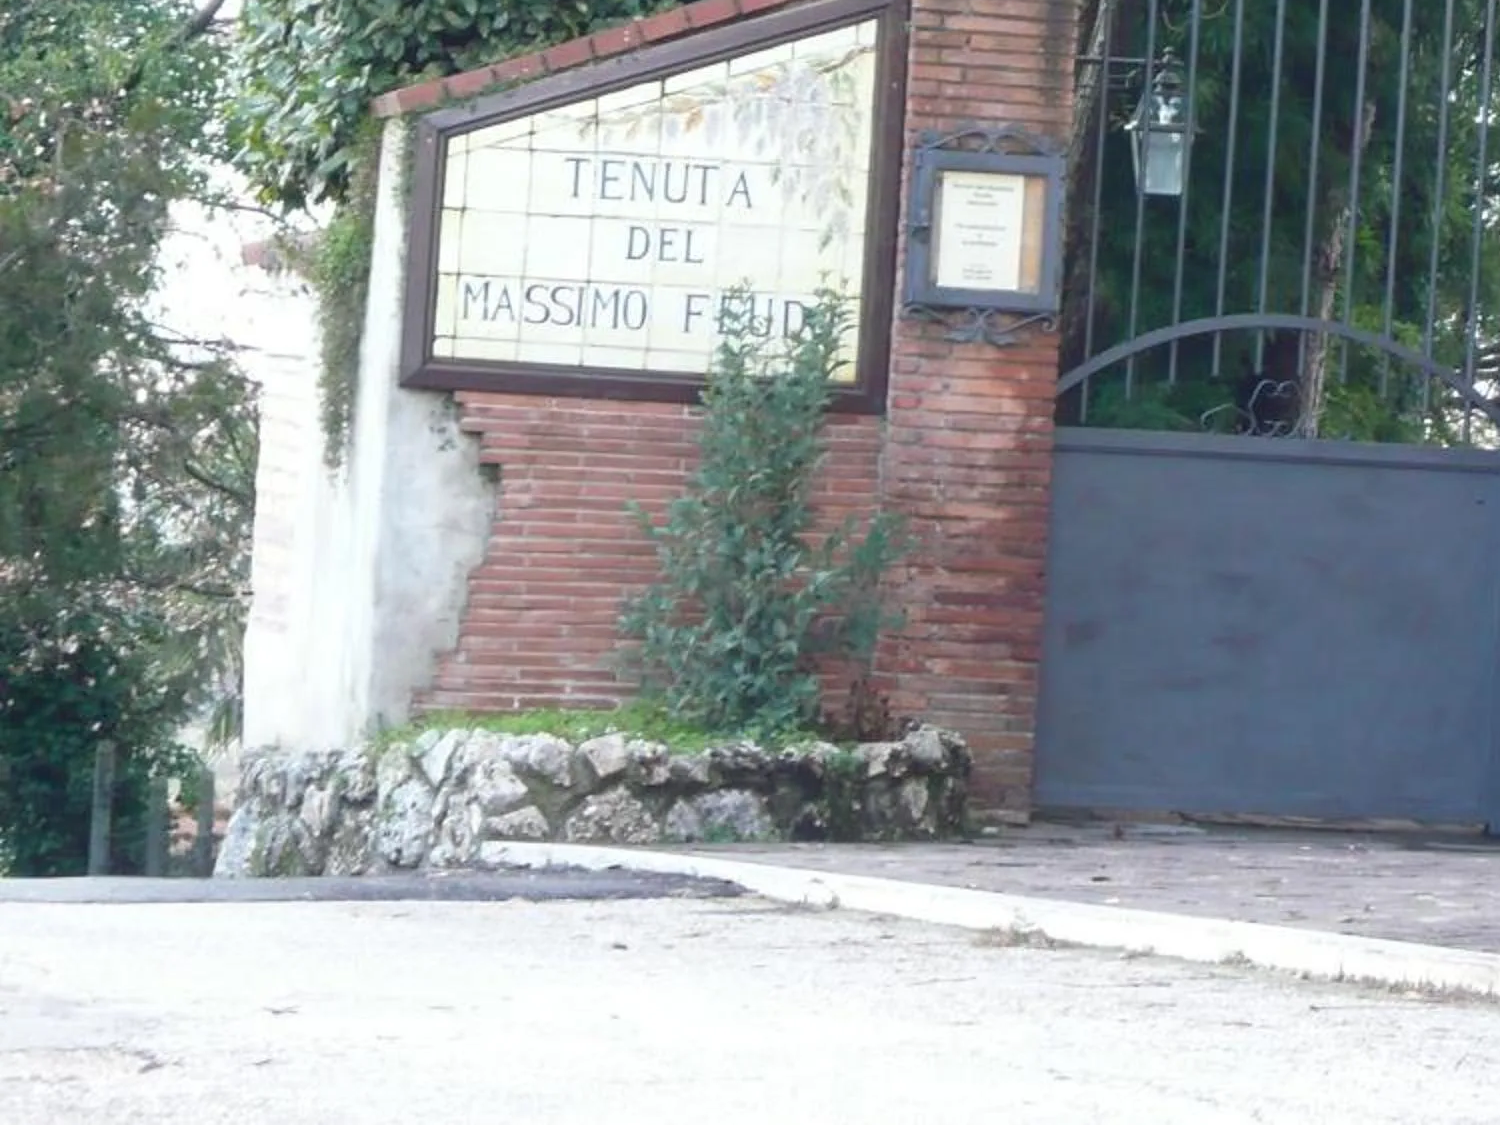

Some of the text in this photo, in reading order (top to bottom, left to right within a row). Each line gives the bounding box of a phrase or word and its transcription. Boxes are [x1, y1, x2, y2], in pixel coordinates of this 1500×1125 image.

[565, 157, 753, 209] TENUTA
[626, 225, 705, 264] DEL
[461, 281, 836, 342] MASSIMO FEUD
